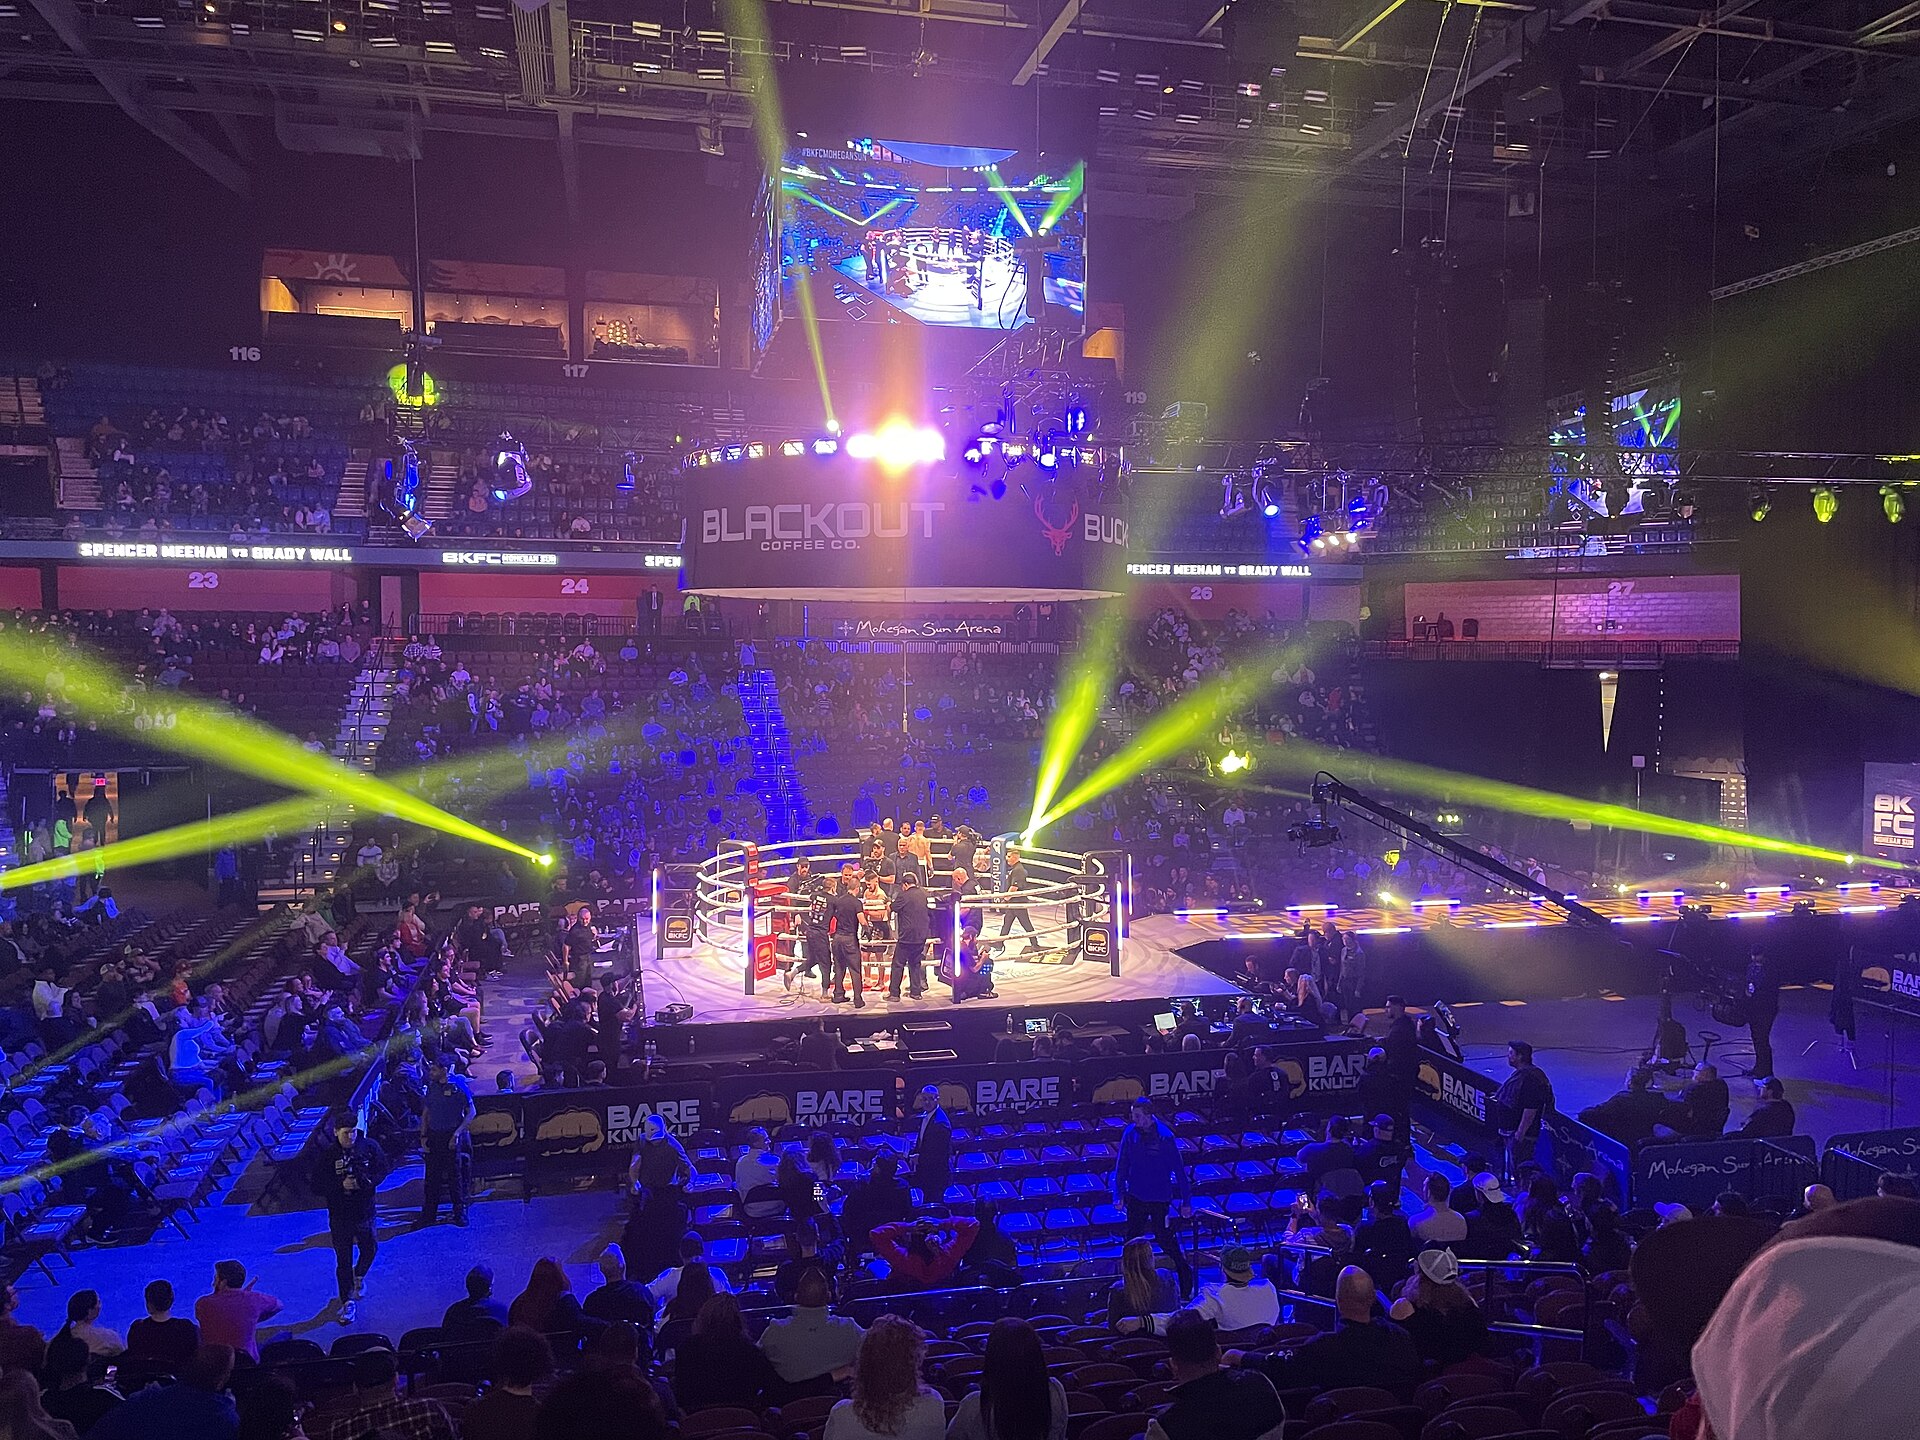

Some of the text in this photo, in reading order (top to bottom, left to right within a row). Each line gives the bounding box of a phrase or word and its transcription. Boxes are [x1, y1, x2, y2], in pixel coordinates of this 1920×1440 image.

[230, 347, 260, 361] 116
[563, 364, 589, 377] 117
[1124, 391, 1147, 404] 119
[703, 503, 945, 543] BLACKOUT
[1085, 513, 1129, 549] BUCK
[81, 543, 157, 557] SPENCER
[161, 545, 227, 559] MEEHAN
[252, 547, 305, 560] BRADY
[310, 548, 352, 561] WALL
[760, 540, 860, 551] COFFEE CO.
[442, 553, 501, 564] BKFC
[188, 572, 218, 588] 23
[1174, 565, 1221, 575] MEEHAN
[1239, 565, 1278, 576] BRADY
[1281, 566, 1311, 576] WALL
[561, 579, 589, 594] 24
[1191, 587, 1213, 600] 26
[1608, 581, 1635, 596] 27
[856, 621, 1001, 637] Mohegan Sun Arena
[1874, 794, 1914, 814] BK
[1874, 812, 1914, 836] FC
[992, 857, 1002, 904] OnlyFas
[1309, 1055, 1366, 1077] BAR
[977, 1077, 1059, 1103] BARE
[1309, 1076, 1360, 1090] KNUCK
[1443, 1072, 1486, 1110] BARE
[796, 1090, 884, 1114] BARE
[1442, 1090, 1486, 1121] KNUCKLE
[607, 1099, 700, 1129] BARE
[607, 1123, 700, 1143] KNLE
[1648, 1155, 1719, 1180] Mohegan
